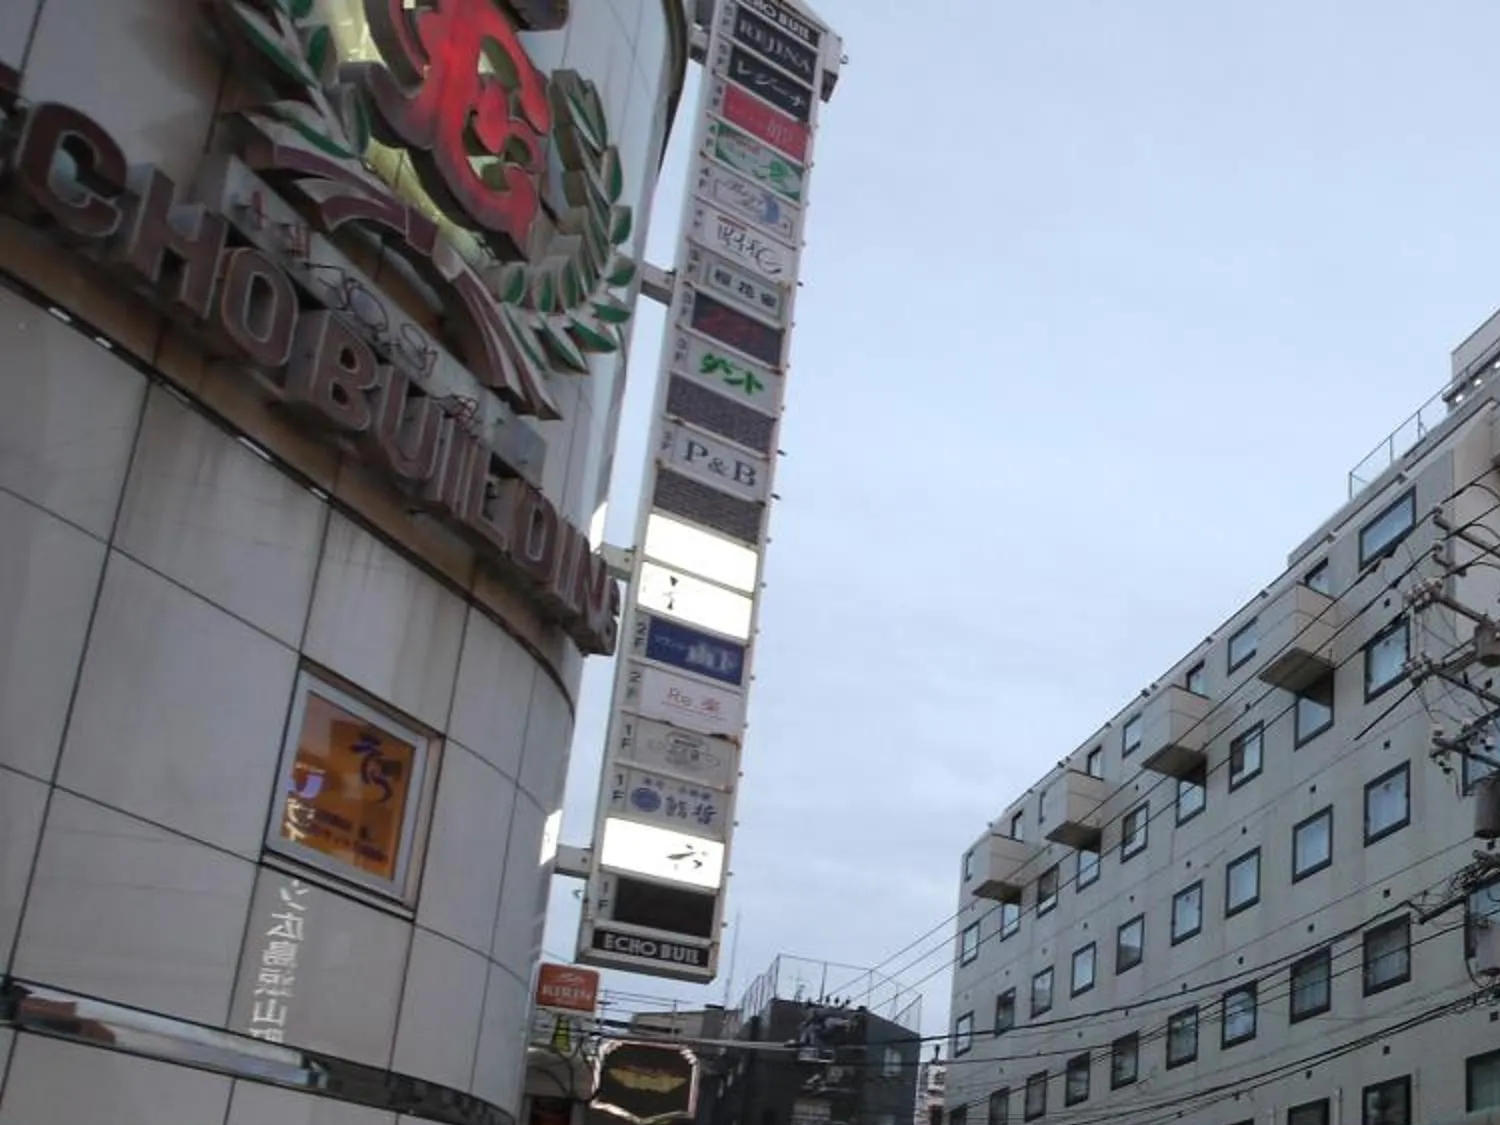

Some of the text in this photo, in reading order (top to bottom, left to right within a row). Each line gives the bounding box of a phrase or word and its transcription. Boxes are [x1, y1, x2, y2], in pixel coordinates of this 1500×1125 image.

[0, 52, 302, 368] CHO
[684, 441, 756, 486] P&B
[604, 932, 657, 956] ECHO
